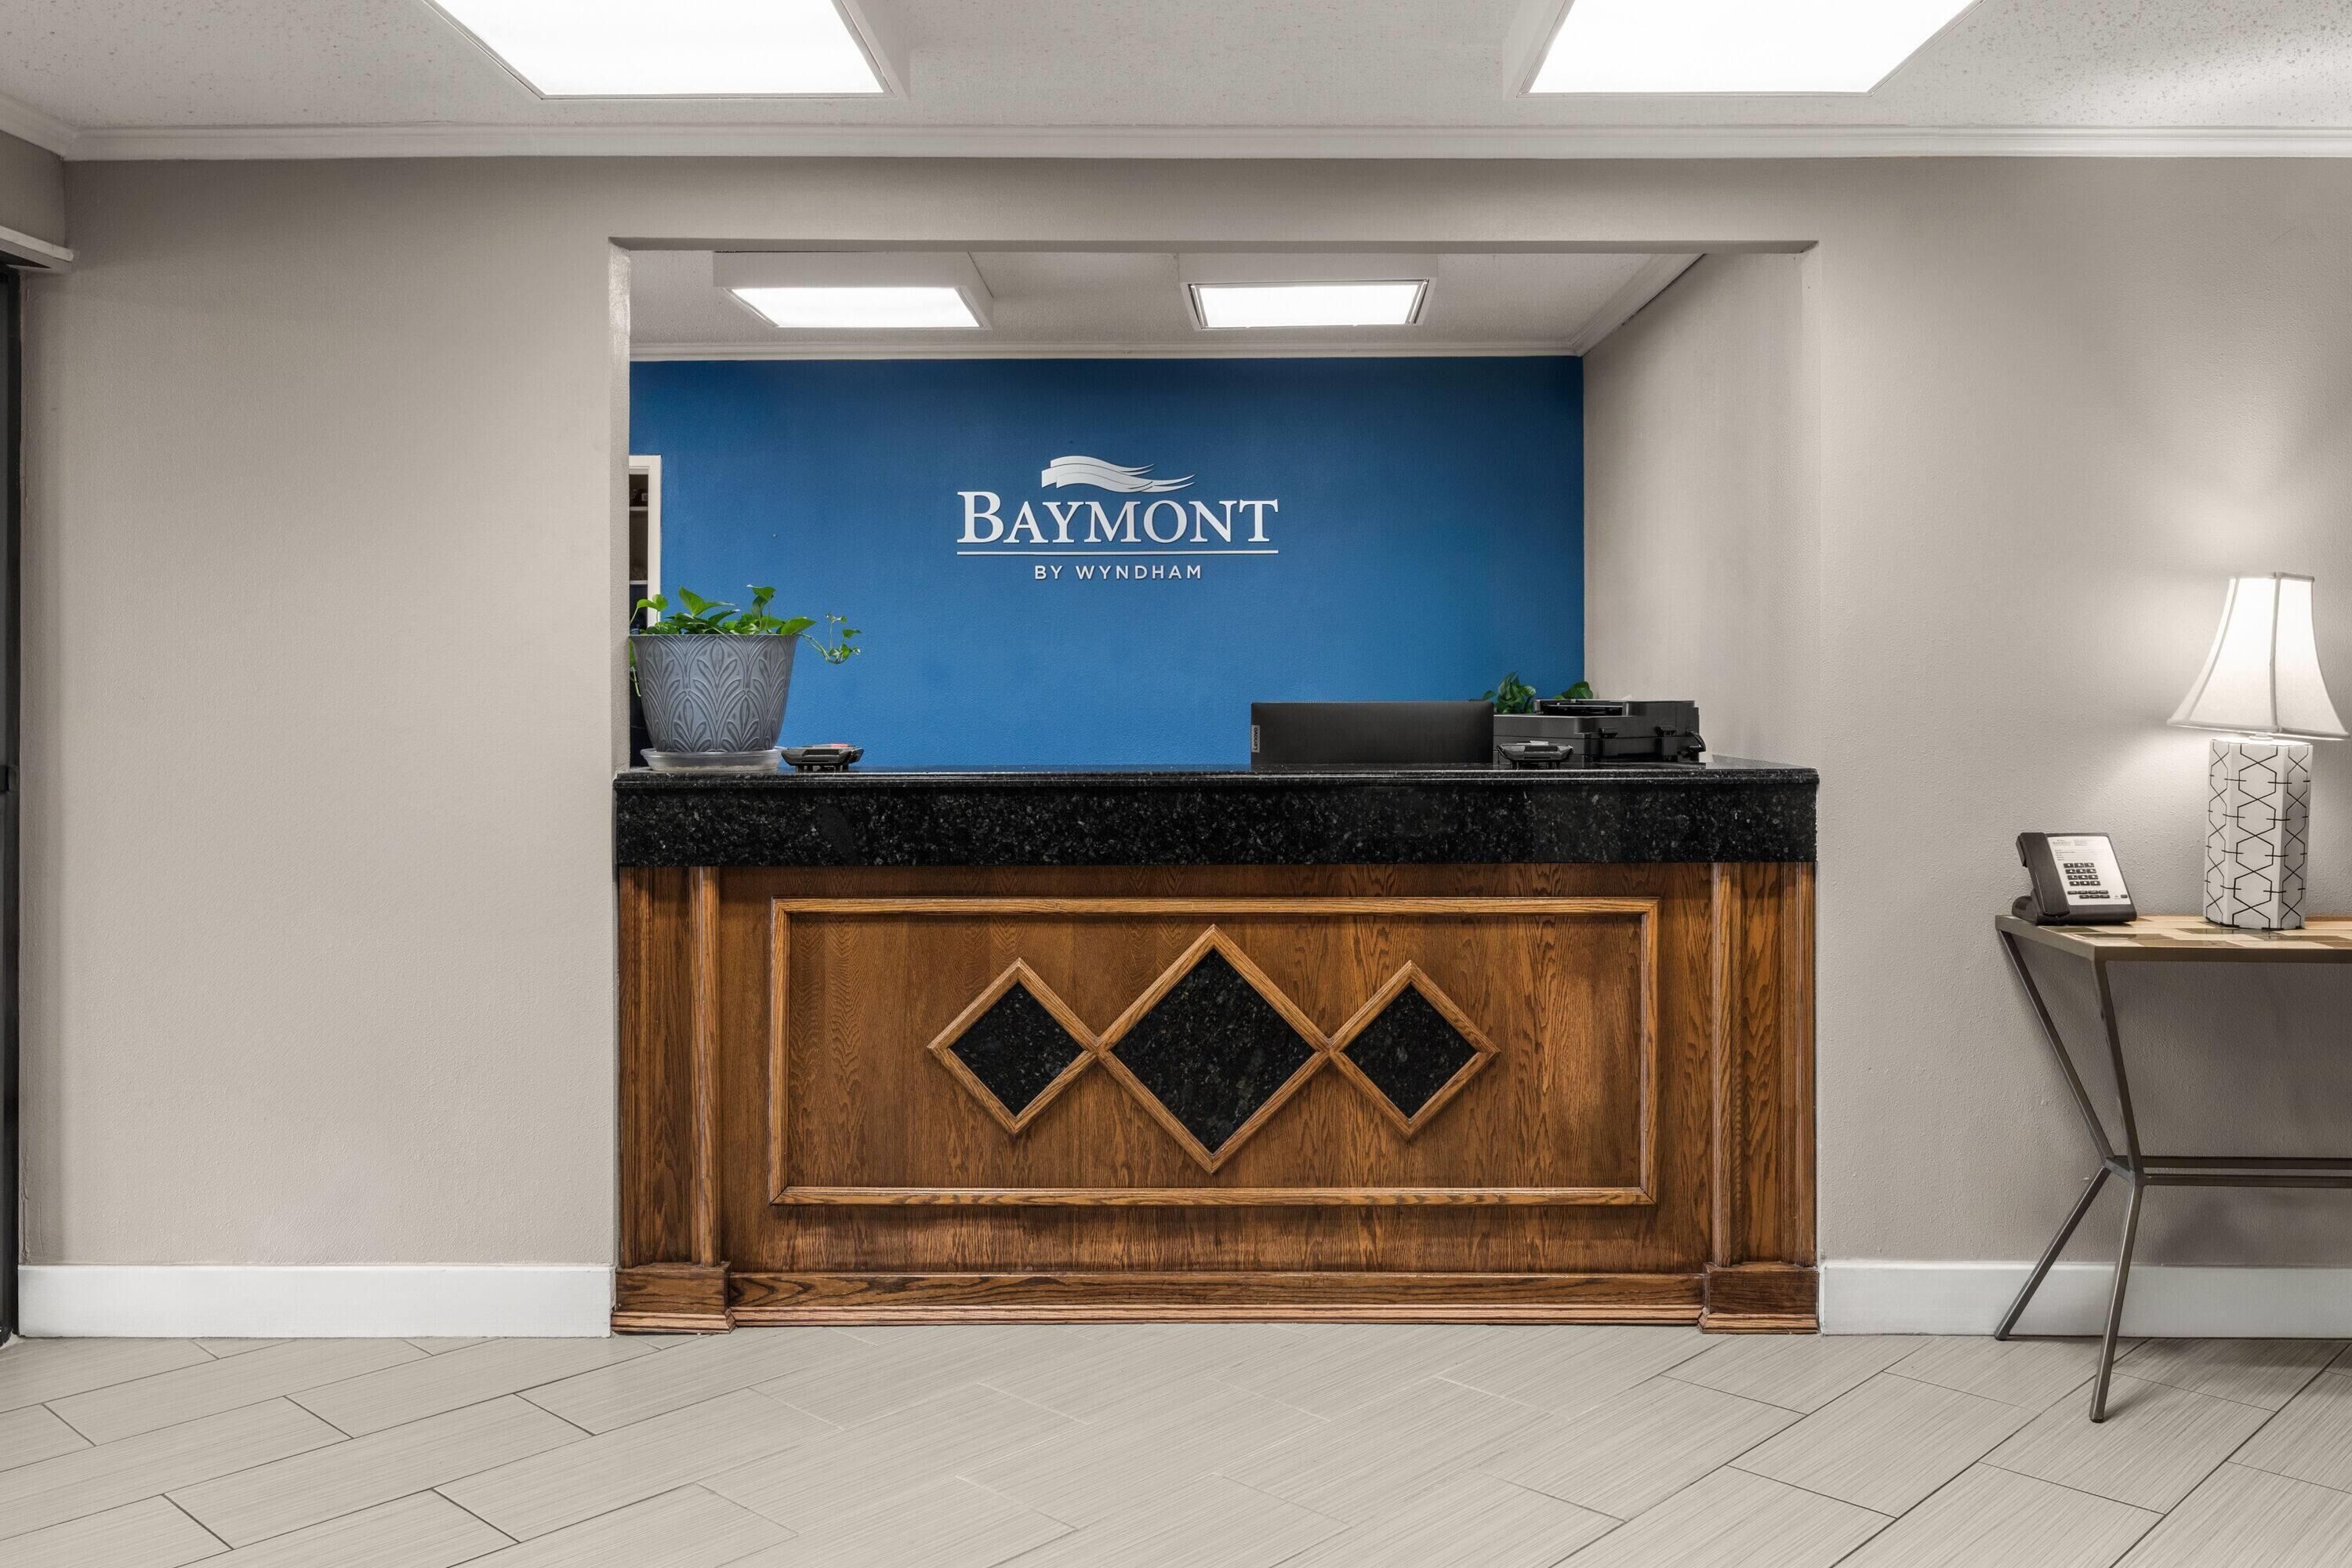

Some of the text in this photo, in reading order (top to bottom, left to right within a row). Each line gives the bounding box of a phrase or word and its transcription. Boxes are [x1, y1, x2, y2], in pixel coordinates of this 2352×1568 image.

[957, 491, 1279, 543] BAYMONT
[1034, 564, 1202, 580] BY WYNDHAM
